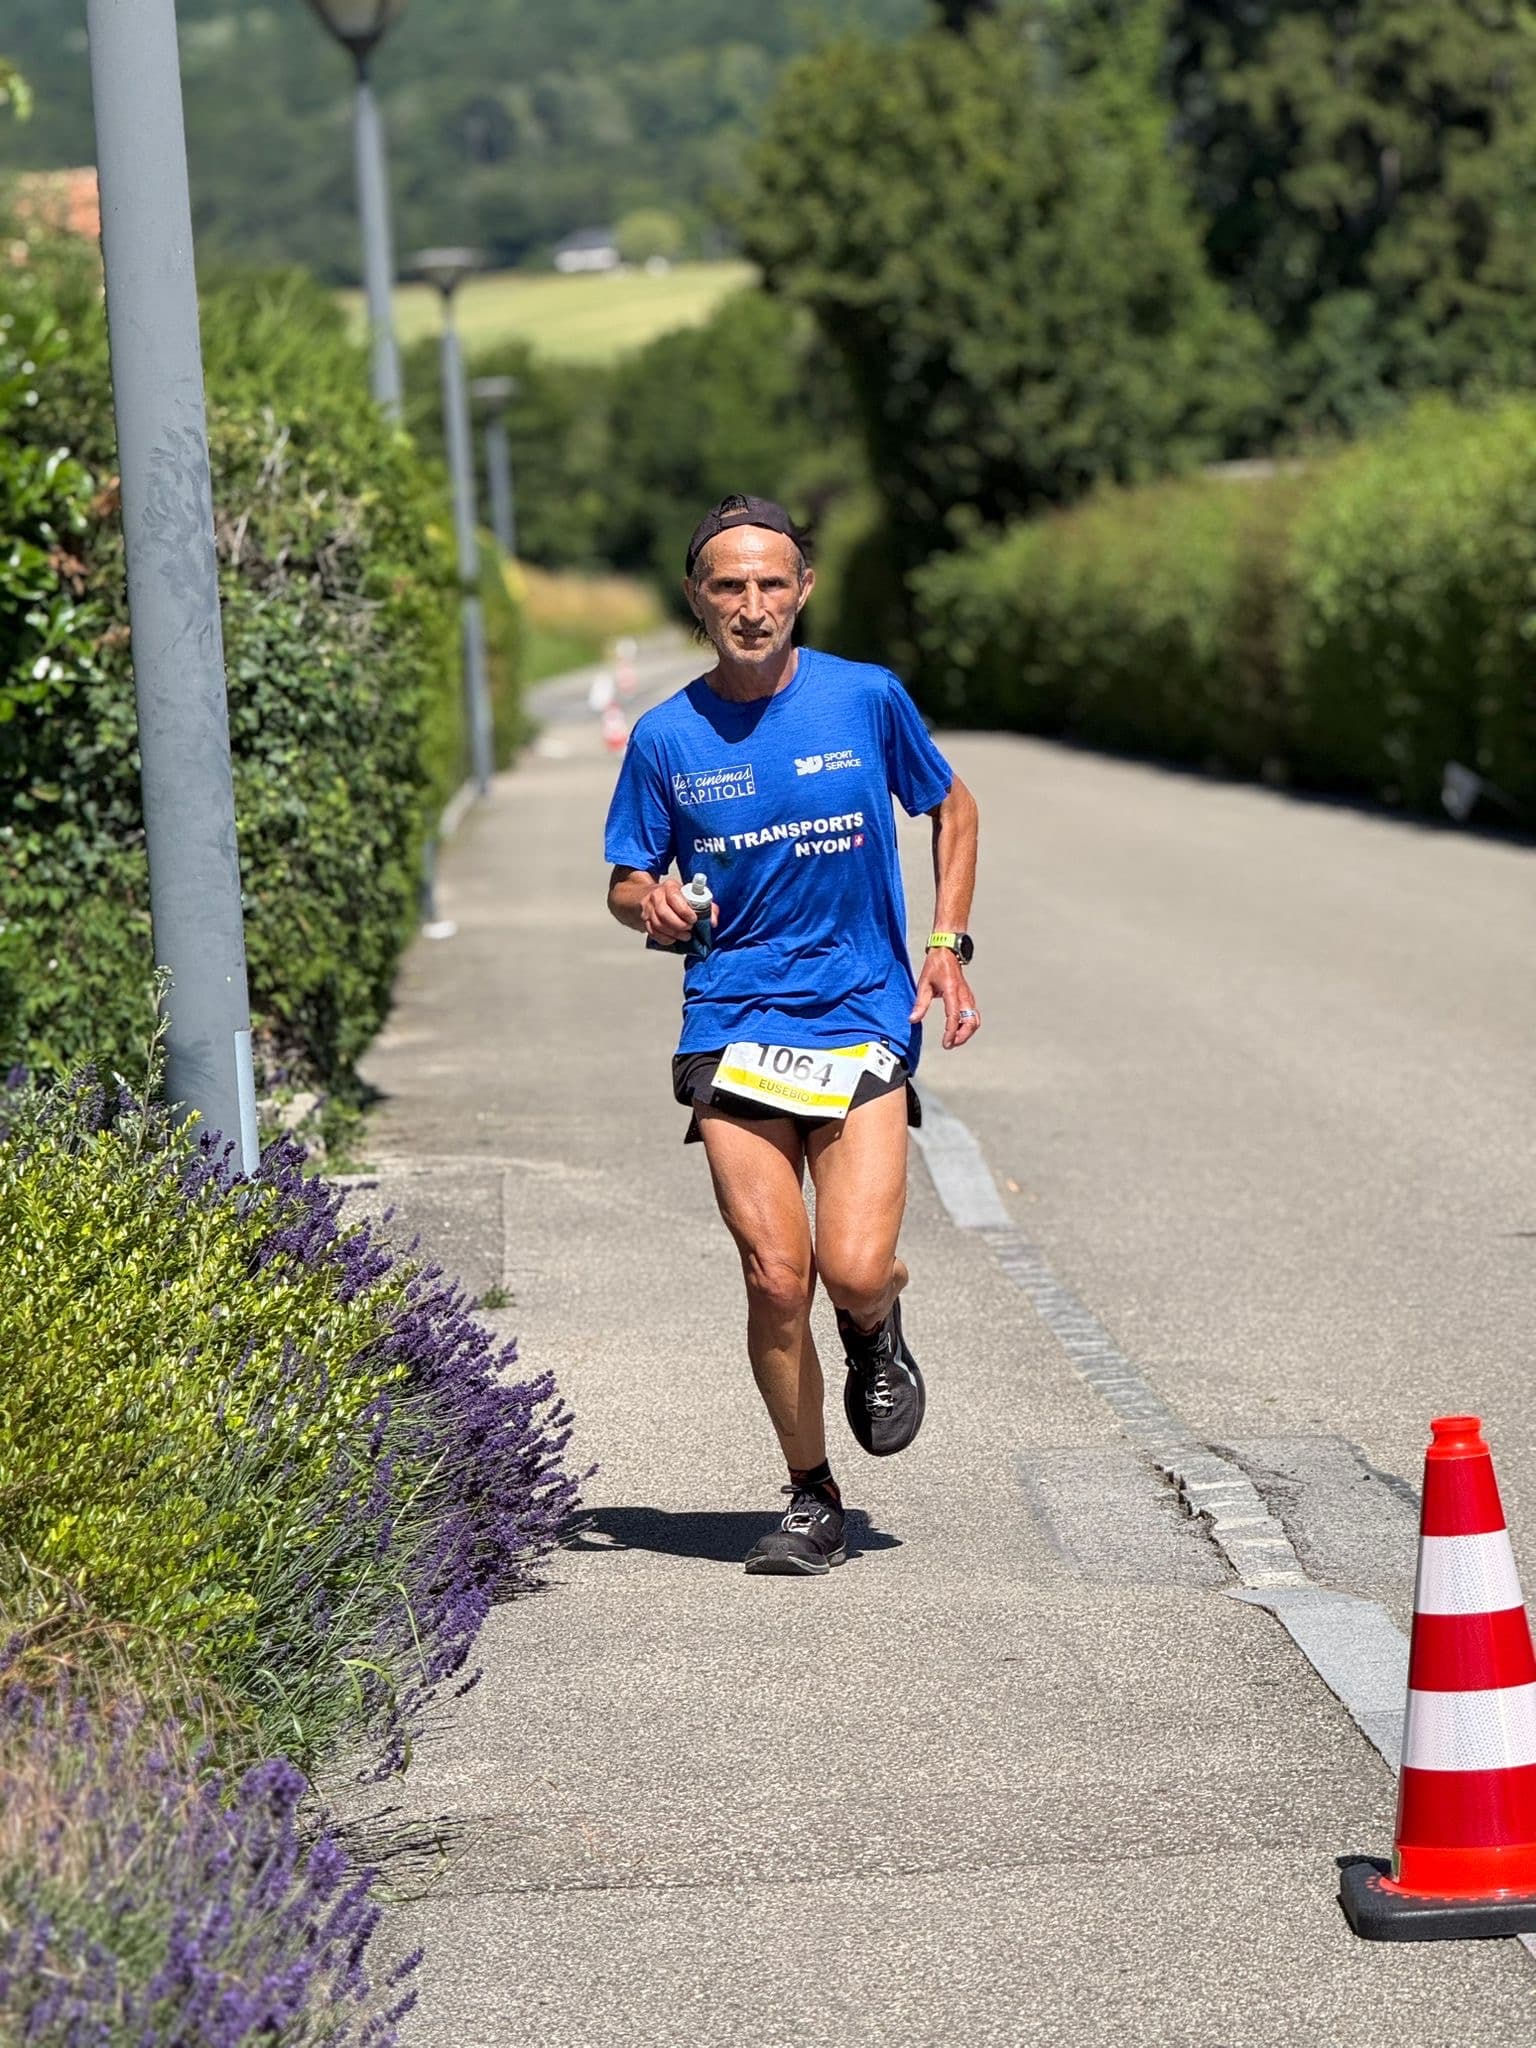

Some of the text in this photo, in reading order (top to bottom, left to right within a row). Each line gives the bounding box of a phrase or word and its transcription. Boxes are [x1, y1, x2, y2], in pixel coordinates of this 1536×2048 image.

[824, 750, 853, 761] SPORT
[825, 758, 862, 771] SERVICE
[695, 768, 752, 787] cinémas
[678, 781, 755, 804] CAPITOLE
[694, 811, 864, 853] CHN TRANSPORTS
[795, 836, 851, 858] NYON
[758, 1043, 834, 1087] 1064
[759, 1078, 810, 1103] EUSEBIO
